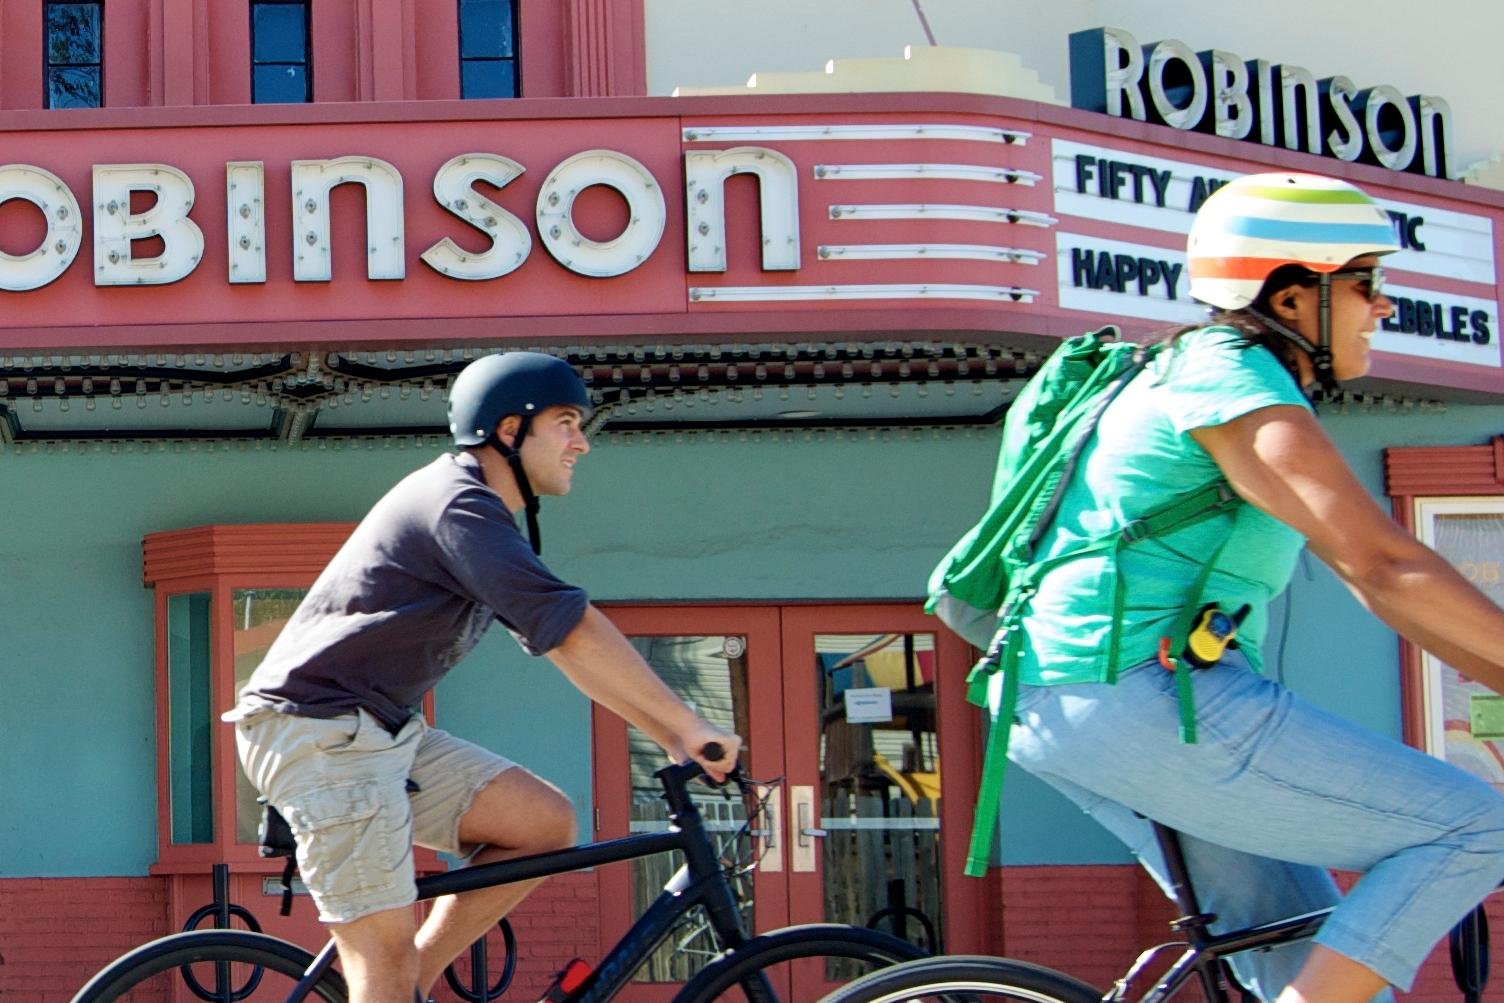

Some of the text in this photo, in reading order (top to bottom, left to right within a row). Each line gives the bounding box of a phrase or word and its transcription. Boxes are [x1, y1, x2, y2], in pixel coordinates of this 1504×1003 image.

[1075, 154, 1171, 208] FIFTY
[1072, 247, 1491, 346] HAPPY EBBLES
